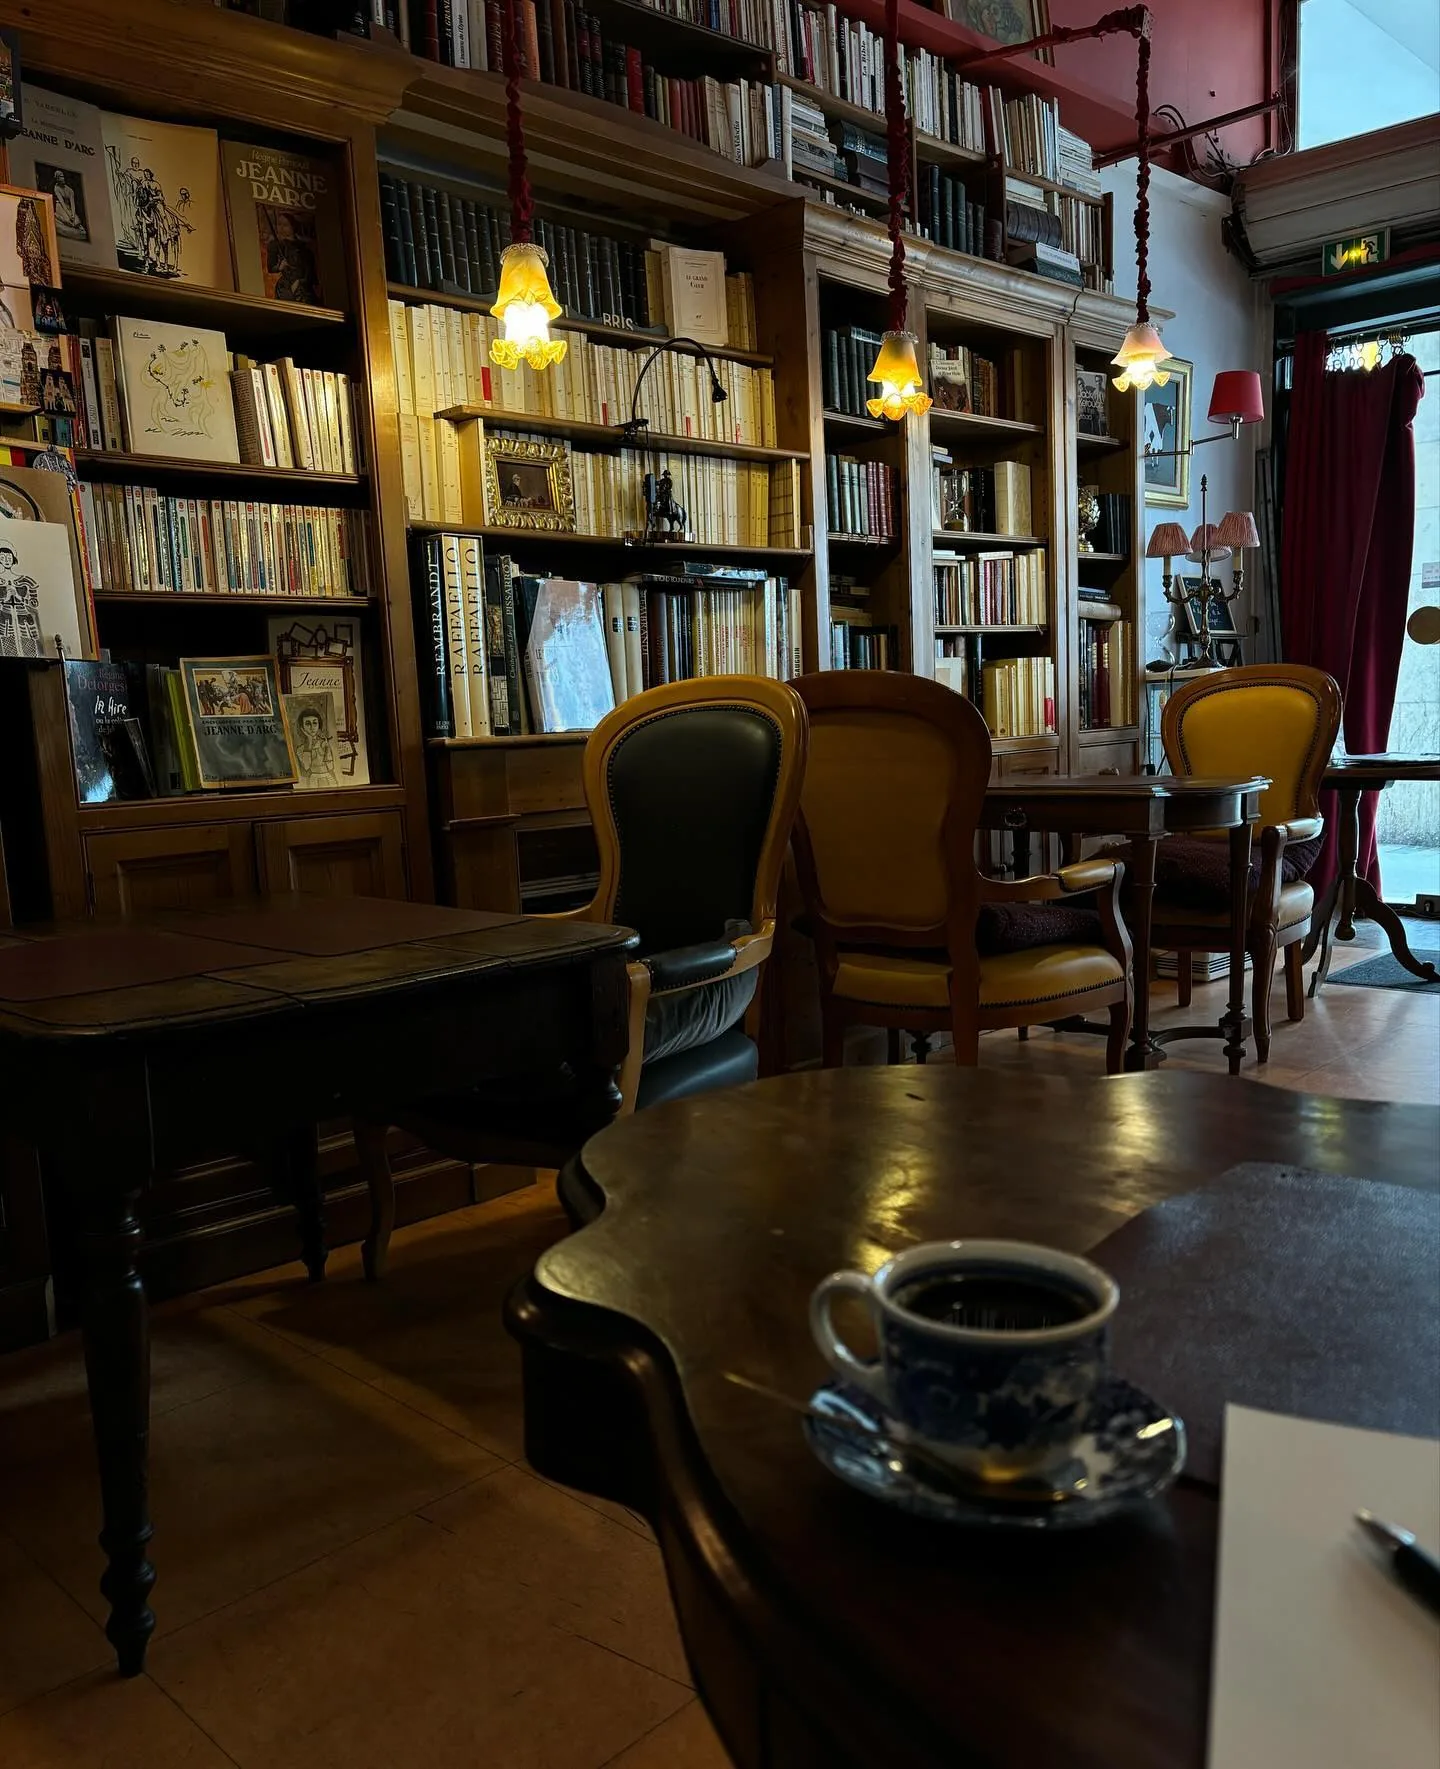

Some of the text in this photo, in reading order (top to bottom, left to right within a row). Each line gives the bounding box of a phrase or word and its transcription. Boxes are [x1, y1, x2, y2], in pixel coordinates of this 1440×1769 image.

[18, 127, 95, 156] EANNE D'ARC
[236, 160, 328, 194] JEANNE
[250, 181, 317, 210] D'ARC
[502, 562, 514, 616] PISSARRO
[428, 561, 446, 676] REMBRANDT
[445, 546, 467, 676] RAFFAELLO
[464, 547, 483, 676] RAFFAELLO
[793, 647, 801, 677] GAUGUIN
[293, 672, 340, 689] Jeanne
[204, 725, 245, 736] JEANNE
